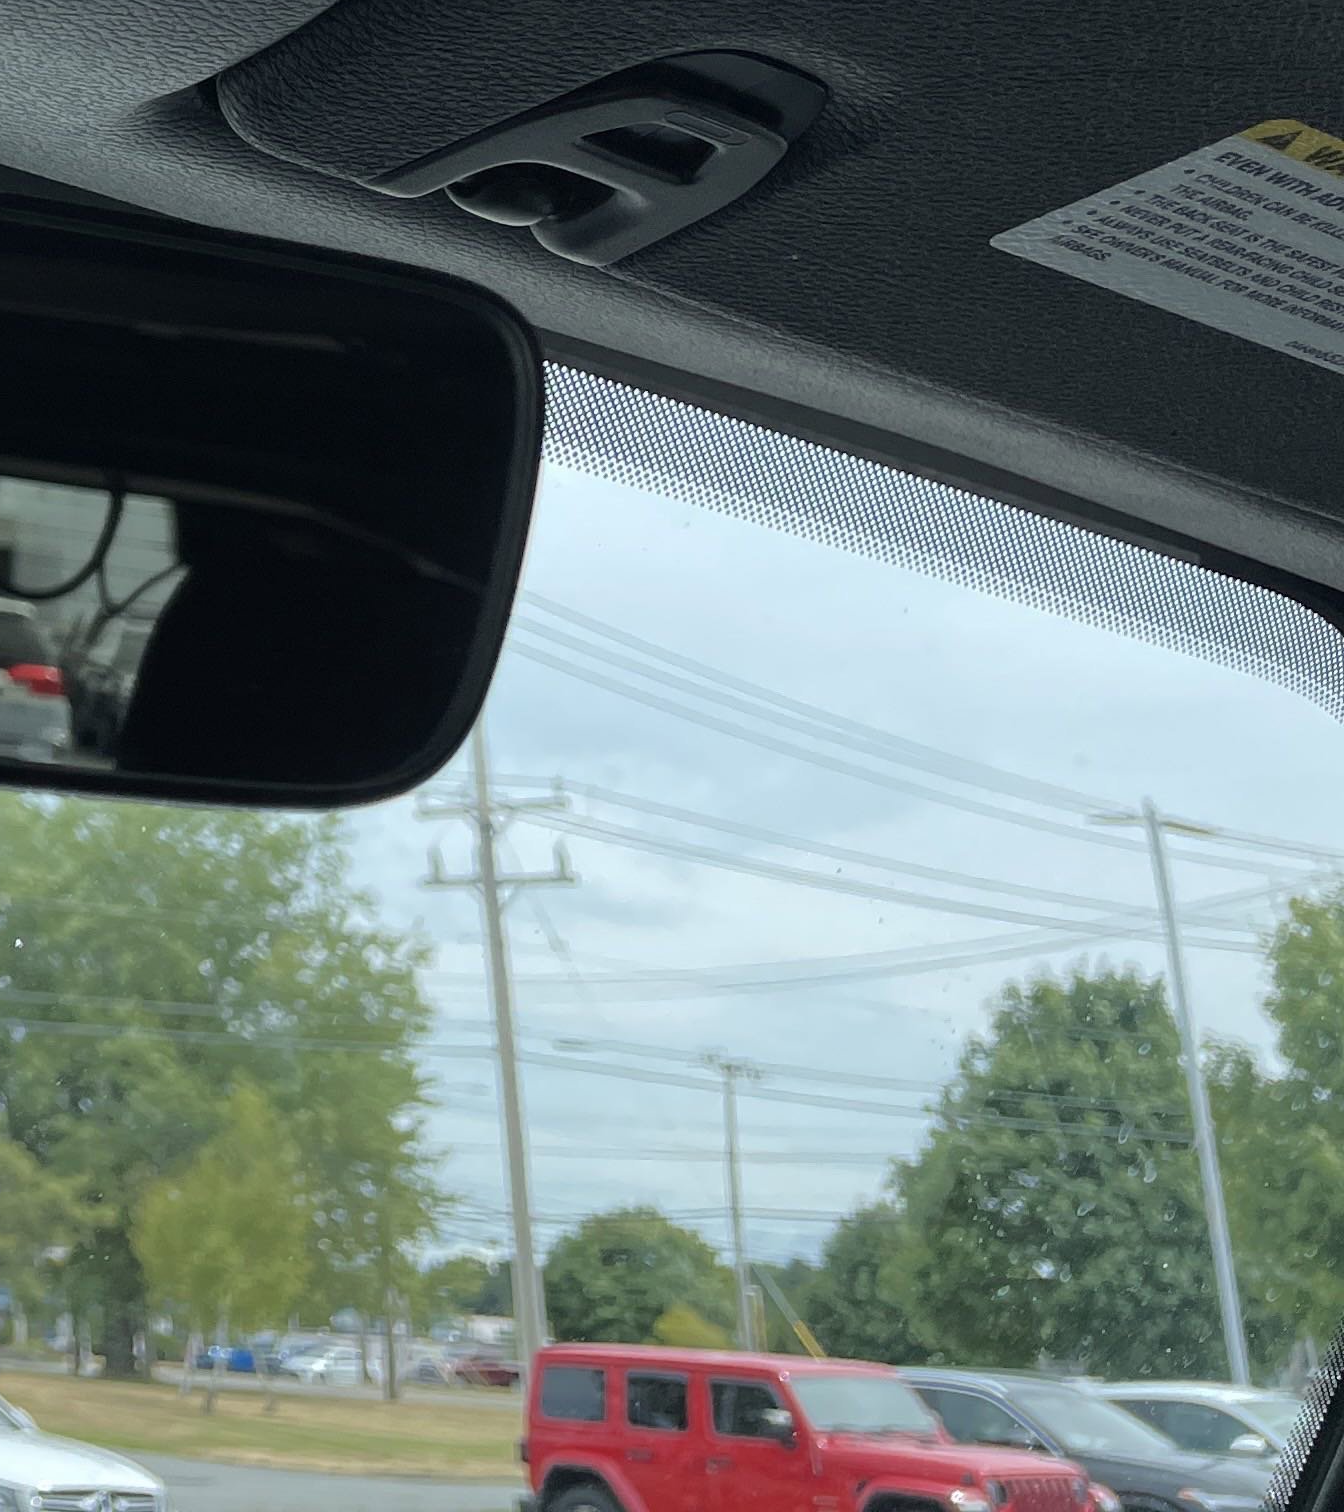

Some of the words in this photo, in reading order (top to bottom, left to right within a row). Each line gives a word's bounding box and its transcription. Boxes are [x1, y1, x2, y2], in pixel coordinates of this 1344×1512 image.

[1170, 184, 1205, 200] THE
[1190, 174, 1269, 206] CHILDREN
[1259, 200, 1299, 217] CAN
[1290, 213, 1319, 225] BE
[1213, 152, 1274, 177] EVEN
[1264, 171, 1322, 197] WITH
[1070, 225, 1105, 239] SEE
[1158, 258, 1220, 284] MANUAL
[1214, 280, 1250, 293] FOR
[1242, 290, 1288, 308] MORE
[1092, 216, 1156, 240] ALWAYS
[1149, 235, 1186, 252] USE
[1246, 274, 1282, 287] AND
[1276, 284, 1321, 302] CHILD
[1119, 205, 1172, 227] NEVER
[1164, 222, 1202, 240] PUT
[1191, 234, 1210, 243] A
[1288, 270, 1336, 289] CHILD
[1143, 194, 1180, 209] THE
[1172, 205, 1220, 224] BACK
[1208, 218, 1251, 237] SEAT
[1257, 239, 1293, 253] THE
[1284, 250, 1341, 271] SAFEST
